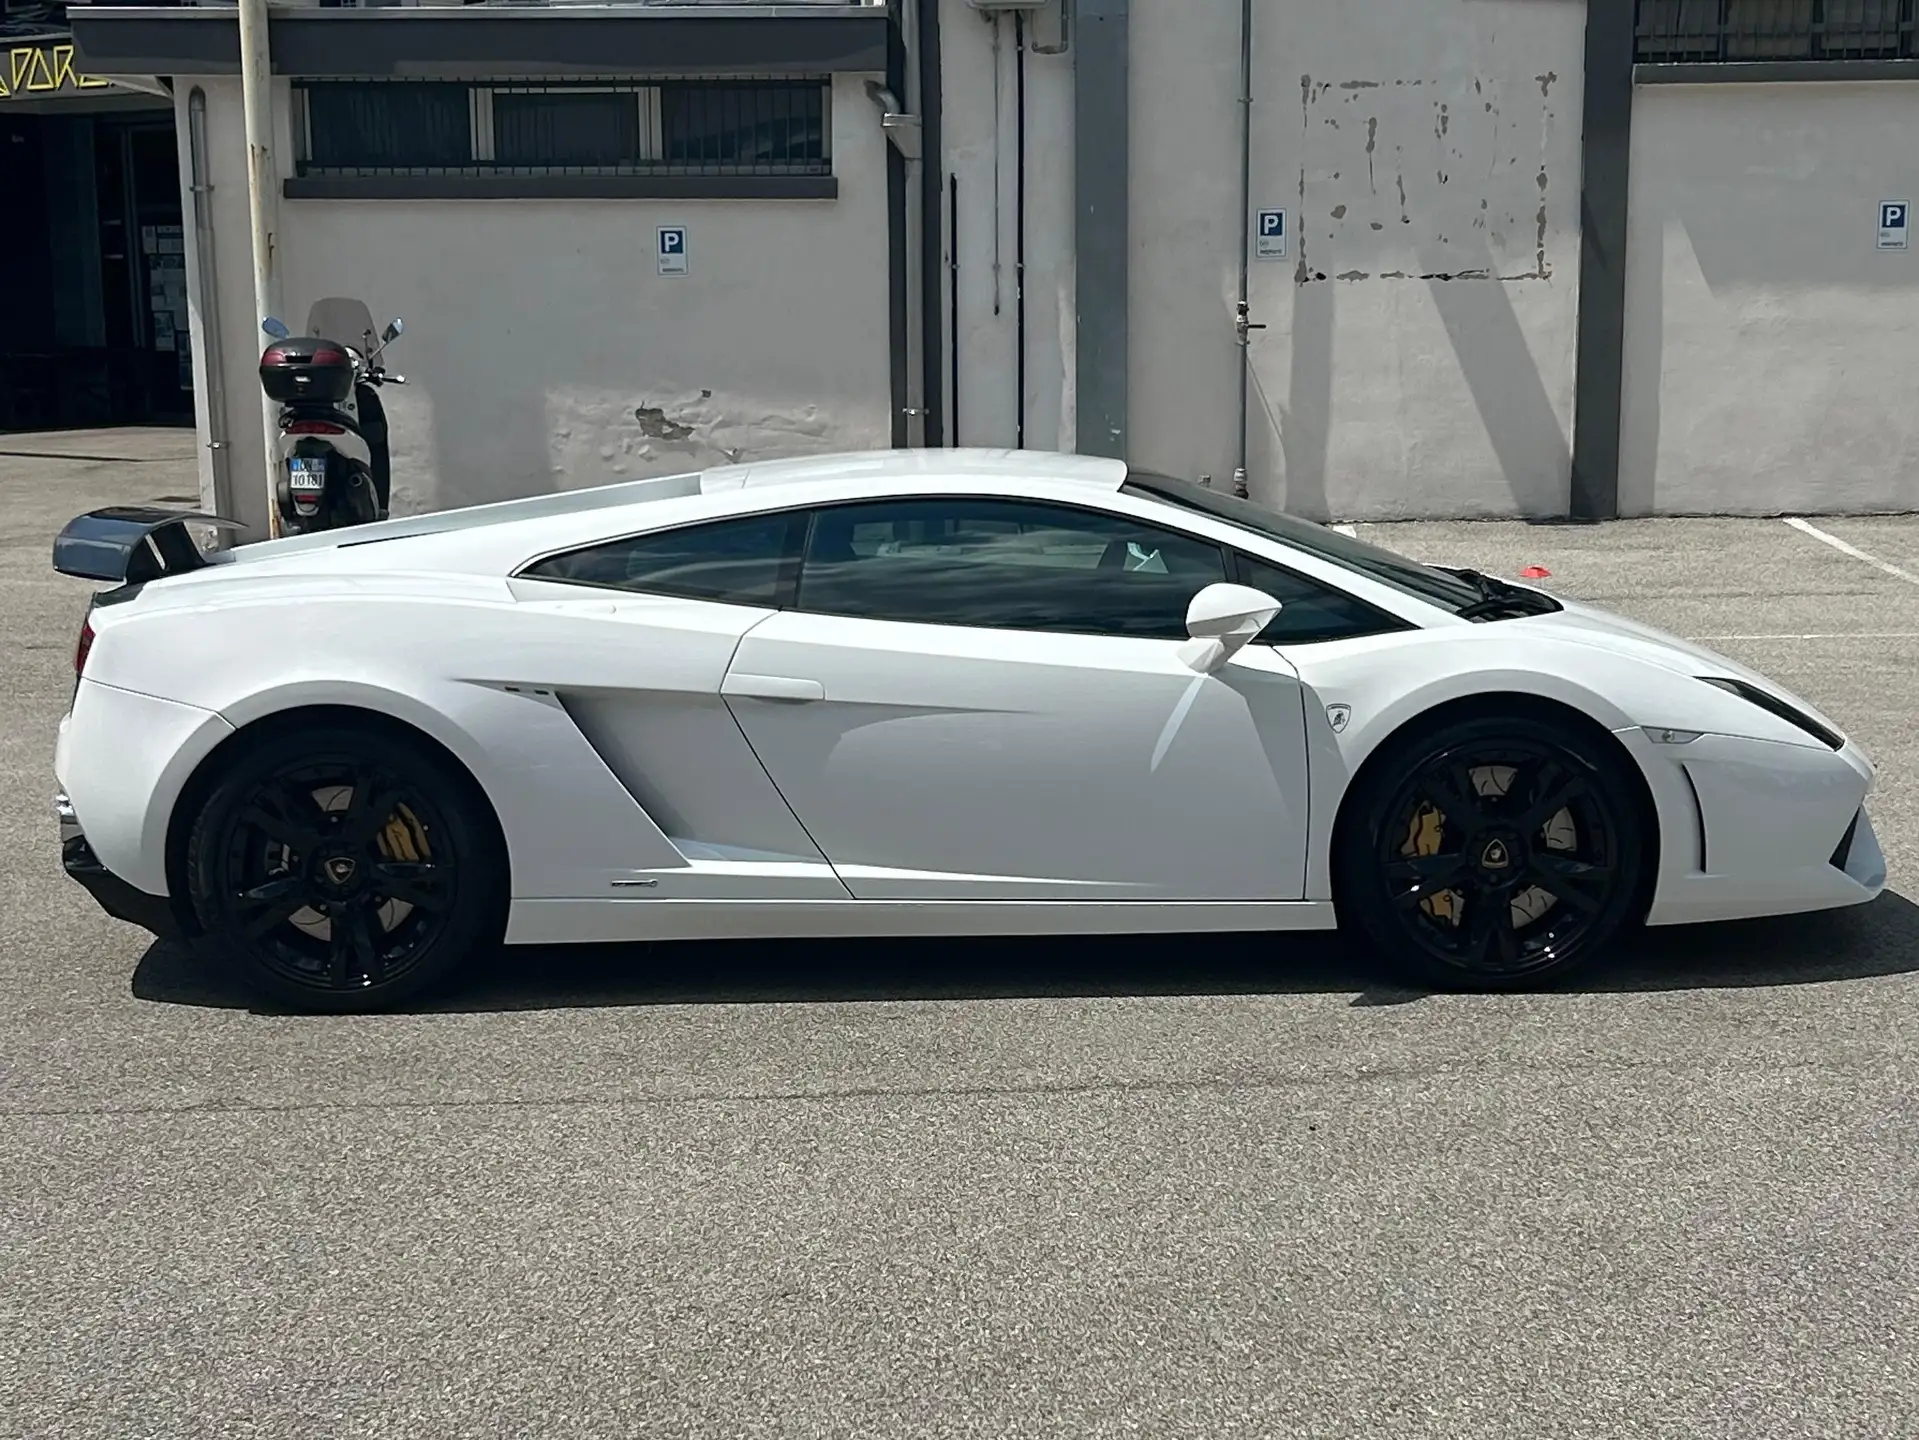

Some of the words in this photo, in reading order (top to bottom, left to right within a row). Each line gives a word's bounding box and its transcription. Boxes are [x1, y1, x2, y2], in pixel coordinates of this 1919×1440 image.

[1264, 215, 1279, 235] P
[1886, 206, 1901, 226] P
[664, 232, 680, 252] P
